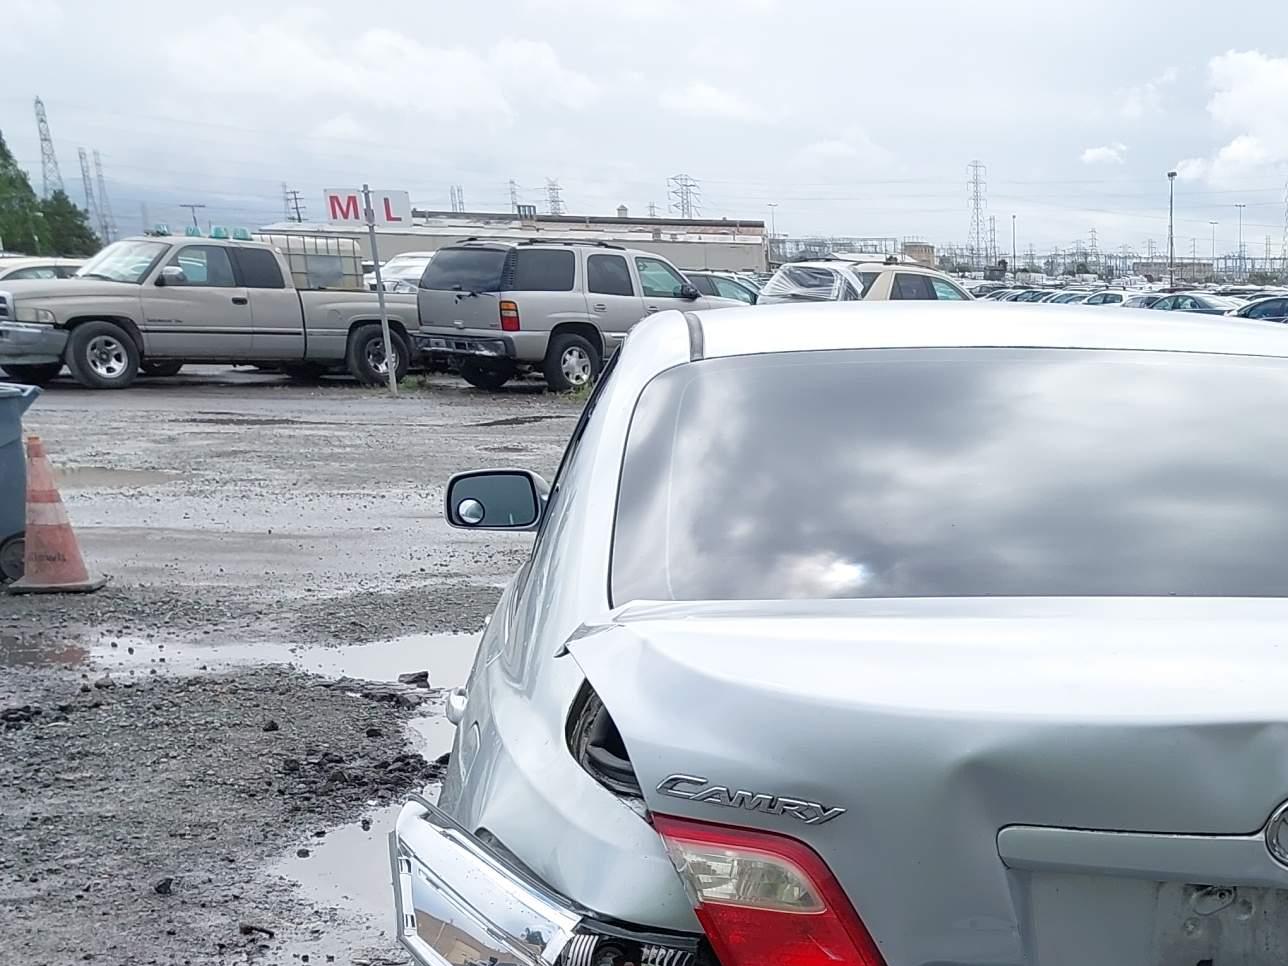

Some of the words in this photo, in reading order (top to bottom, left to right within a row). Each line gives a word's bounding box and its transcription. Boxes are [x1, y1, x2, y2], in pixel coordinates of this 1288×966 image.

[329, 195, 360, 220] M
[383, 197, 402, 221] L
[656, 773, 848, 824] CAMRY
